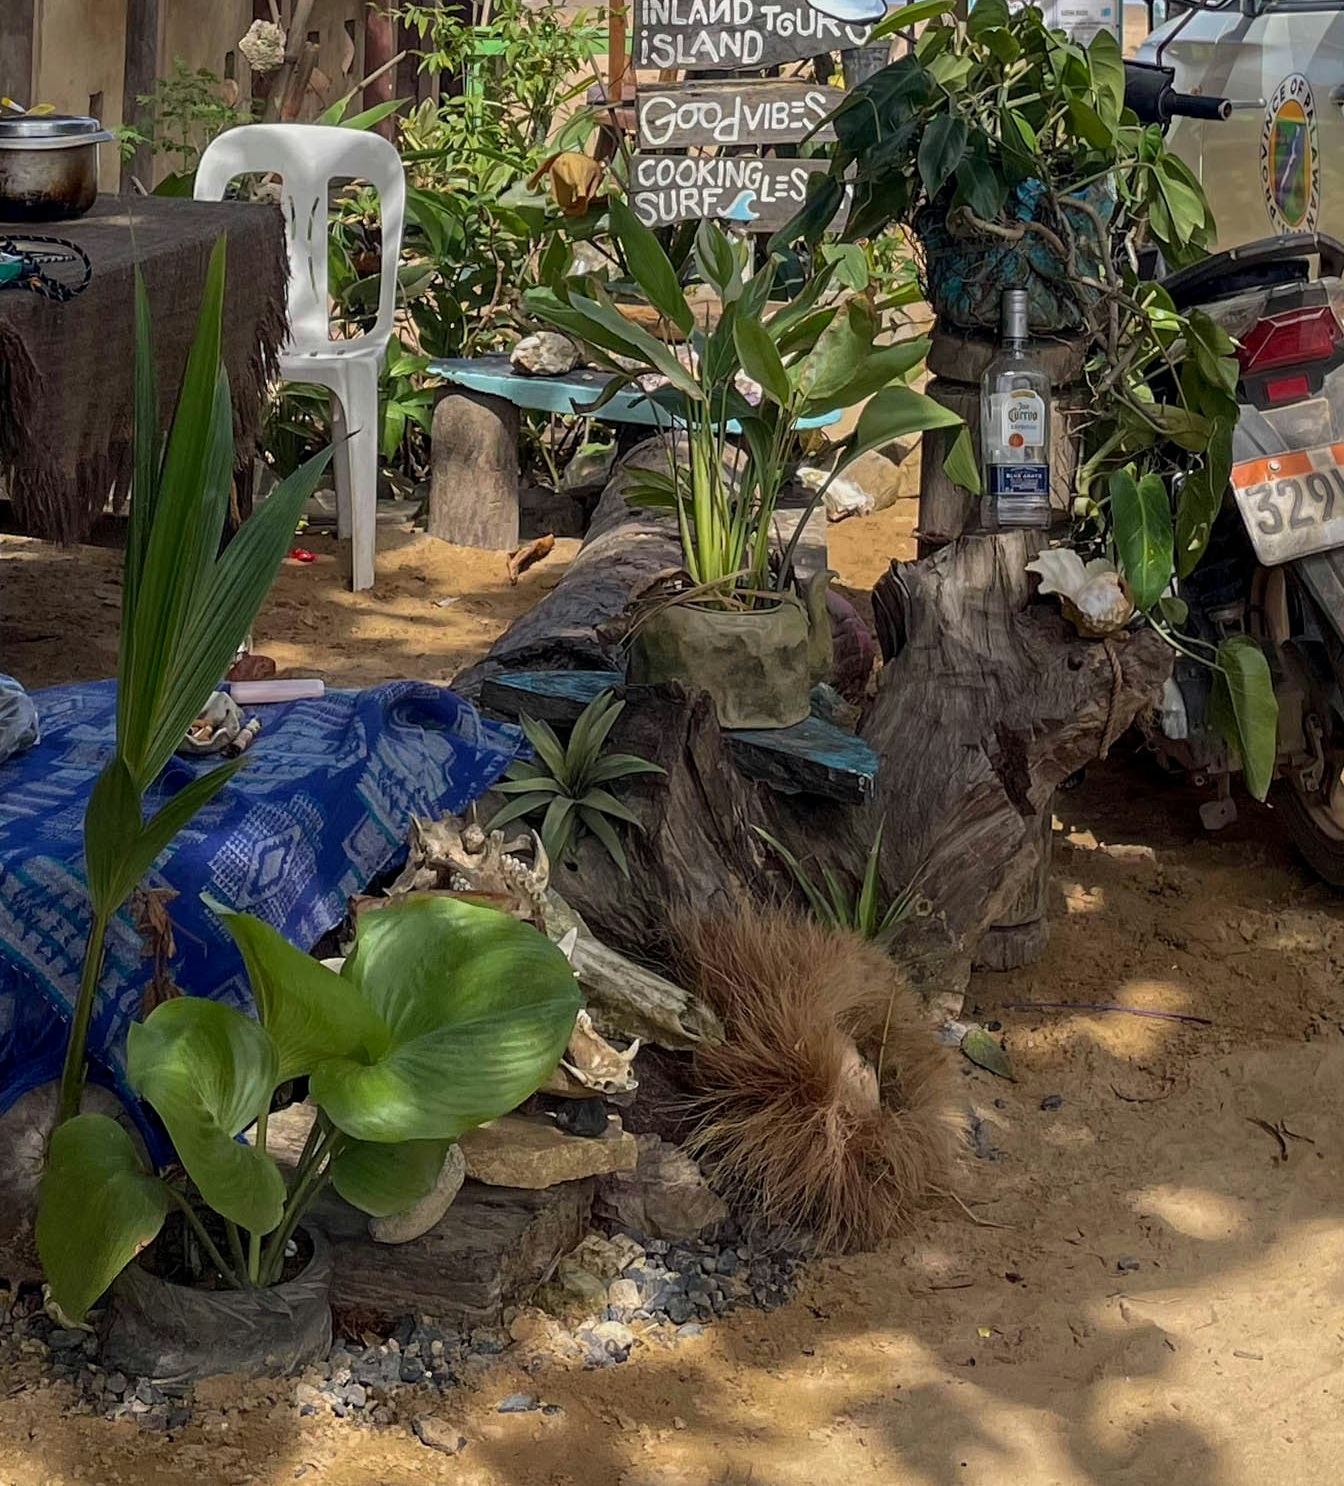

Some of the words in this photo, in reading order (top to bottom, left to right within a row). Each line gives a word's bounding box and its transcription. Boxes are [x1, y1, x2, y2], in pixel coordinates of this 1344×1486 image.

[1289, 77, 1305, 97] OF
[743, 91, 827, 132] VIBES
[637, 159, 763, 190] COOKING
[635, 187, 723, 228] SURF
